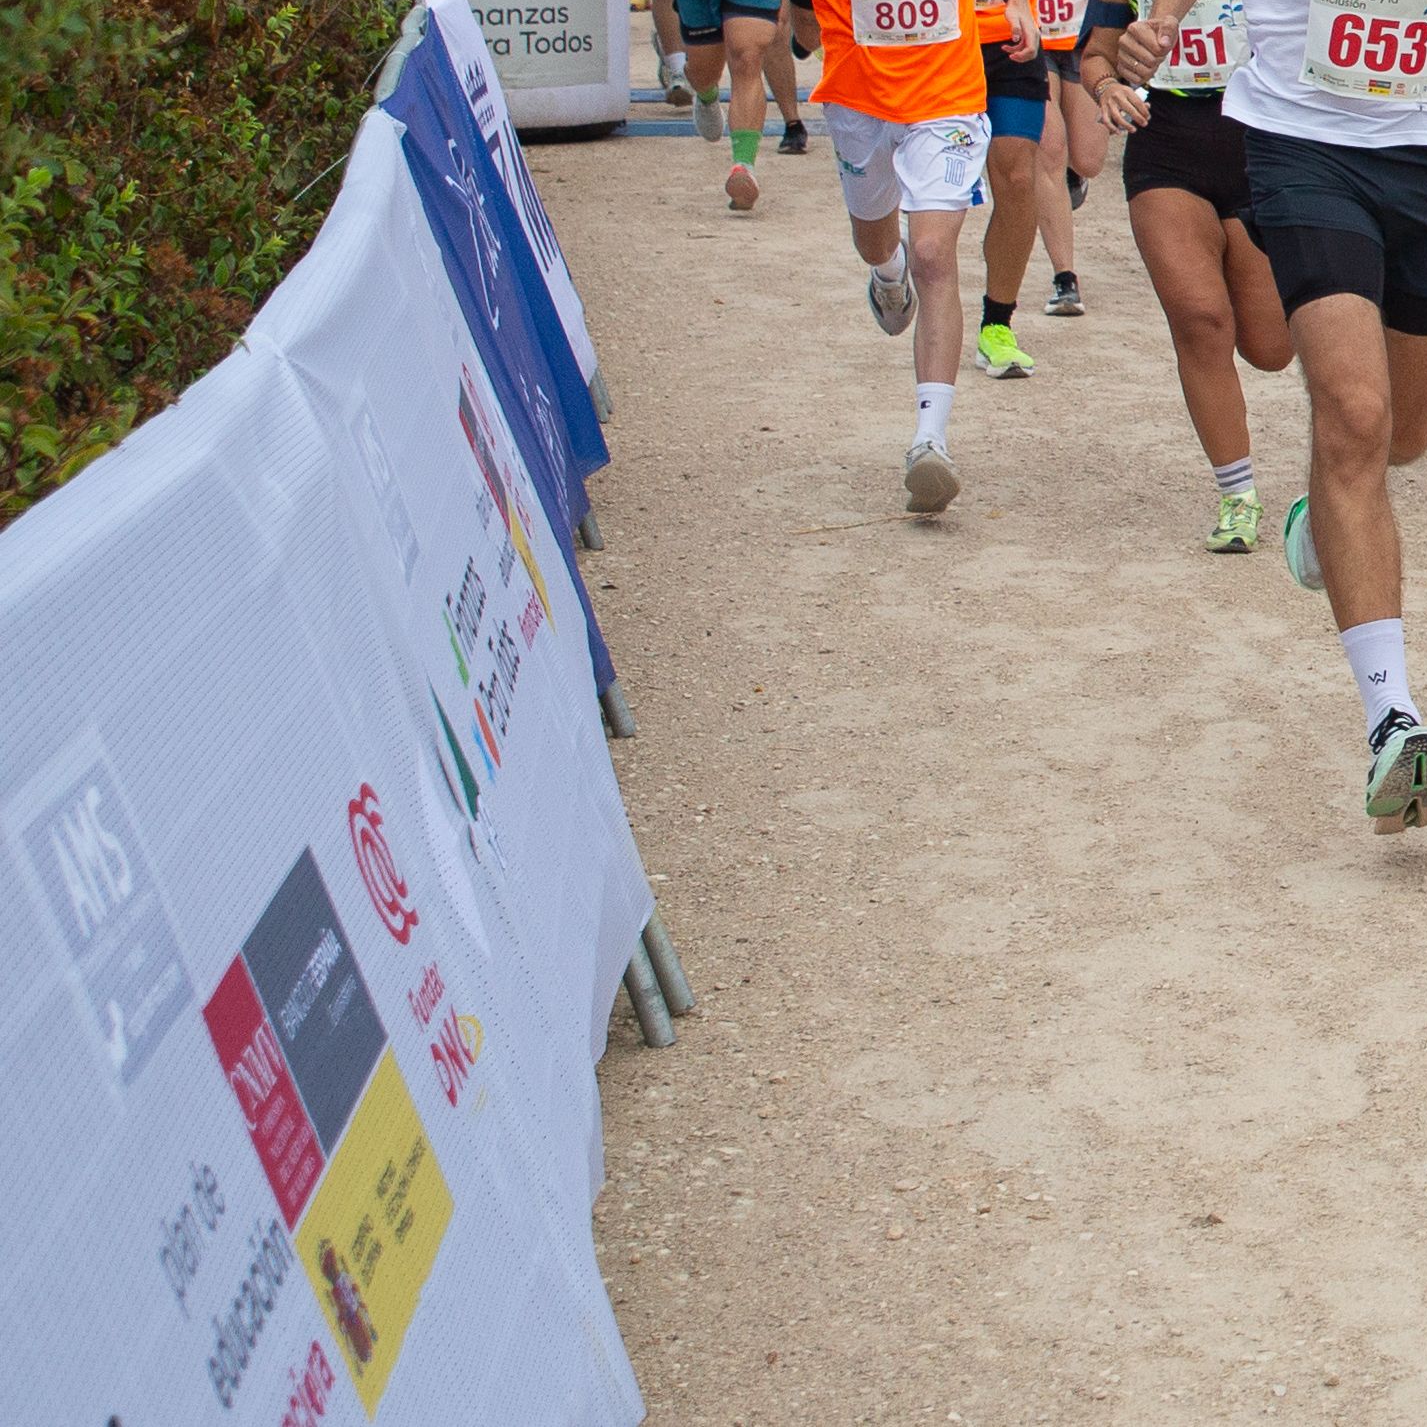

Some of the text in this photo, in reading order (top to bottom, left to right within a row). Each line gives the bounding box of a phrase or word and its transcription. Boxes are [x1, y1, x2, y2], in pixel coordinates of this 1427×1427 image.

[472, 6, 569, 25] nanzas
[487, 31, 592, 55] ra Todos
[876, 0, 939, 30] 809
[52, 786, 133, 939] AMS
[230, 1019, 285, 1131] CNMV
[430, 1004, 476, 1108] ONC
[160, 1161, 225, 1320] plan de
[207, 1217, 295, 1410] educación
